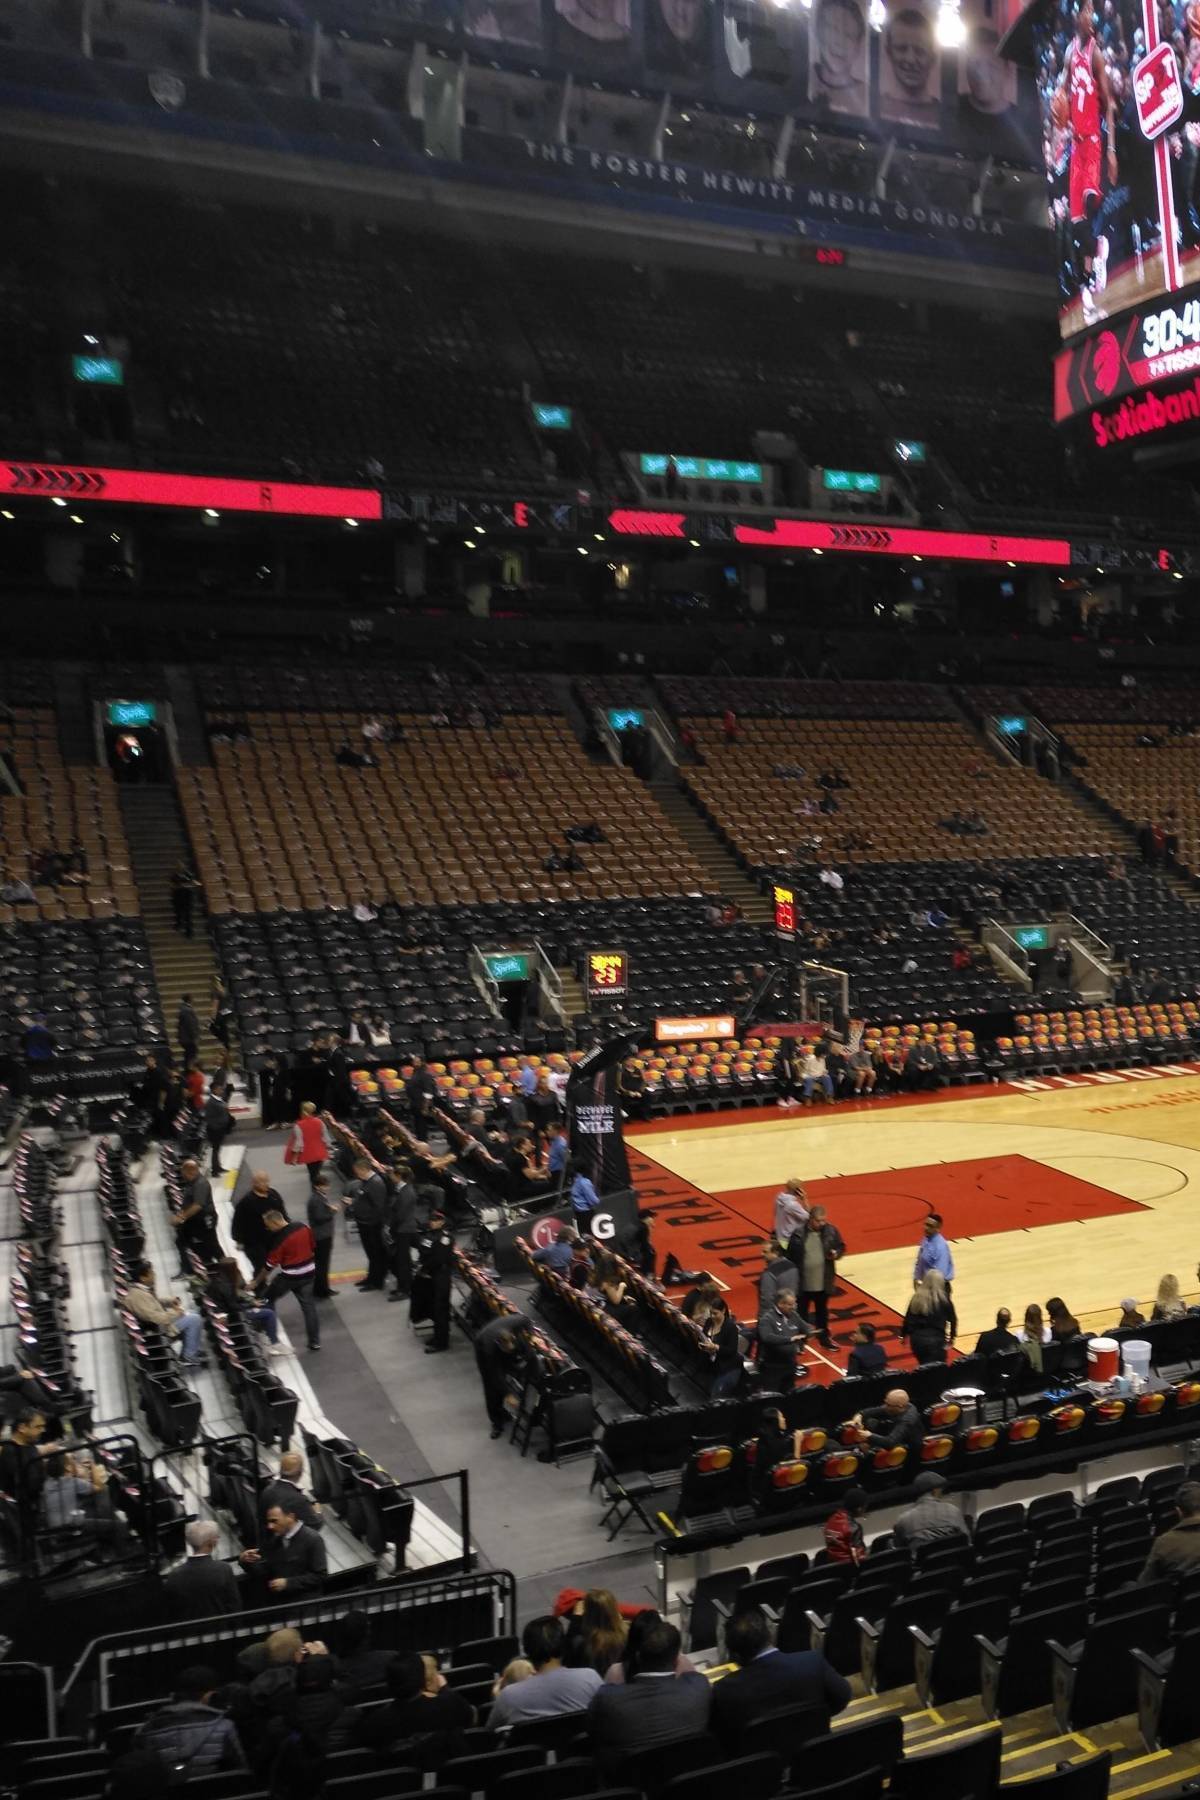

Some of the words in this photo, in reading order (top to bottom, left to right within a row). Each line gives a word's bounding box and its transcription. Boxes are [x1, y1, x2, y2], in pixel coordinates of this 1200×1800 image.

[525, 139, 574, 166] THE
[590, 151, 688, 185] FOSTER
[703, 171, 794, 202] HEWITT
[807, 189, 882, 217] MEDIA
[895, 201, 1004, 237] GONDOLA
[595, 967, 617, 984] 23
[1008, 1064, 1199, 1093] NORTH
